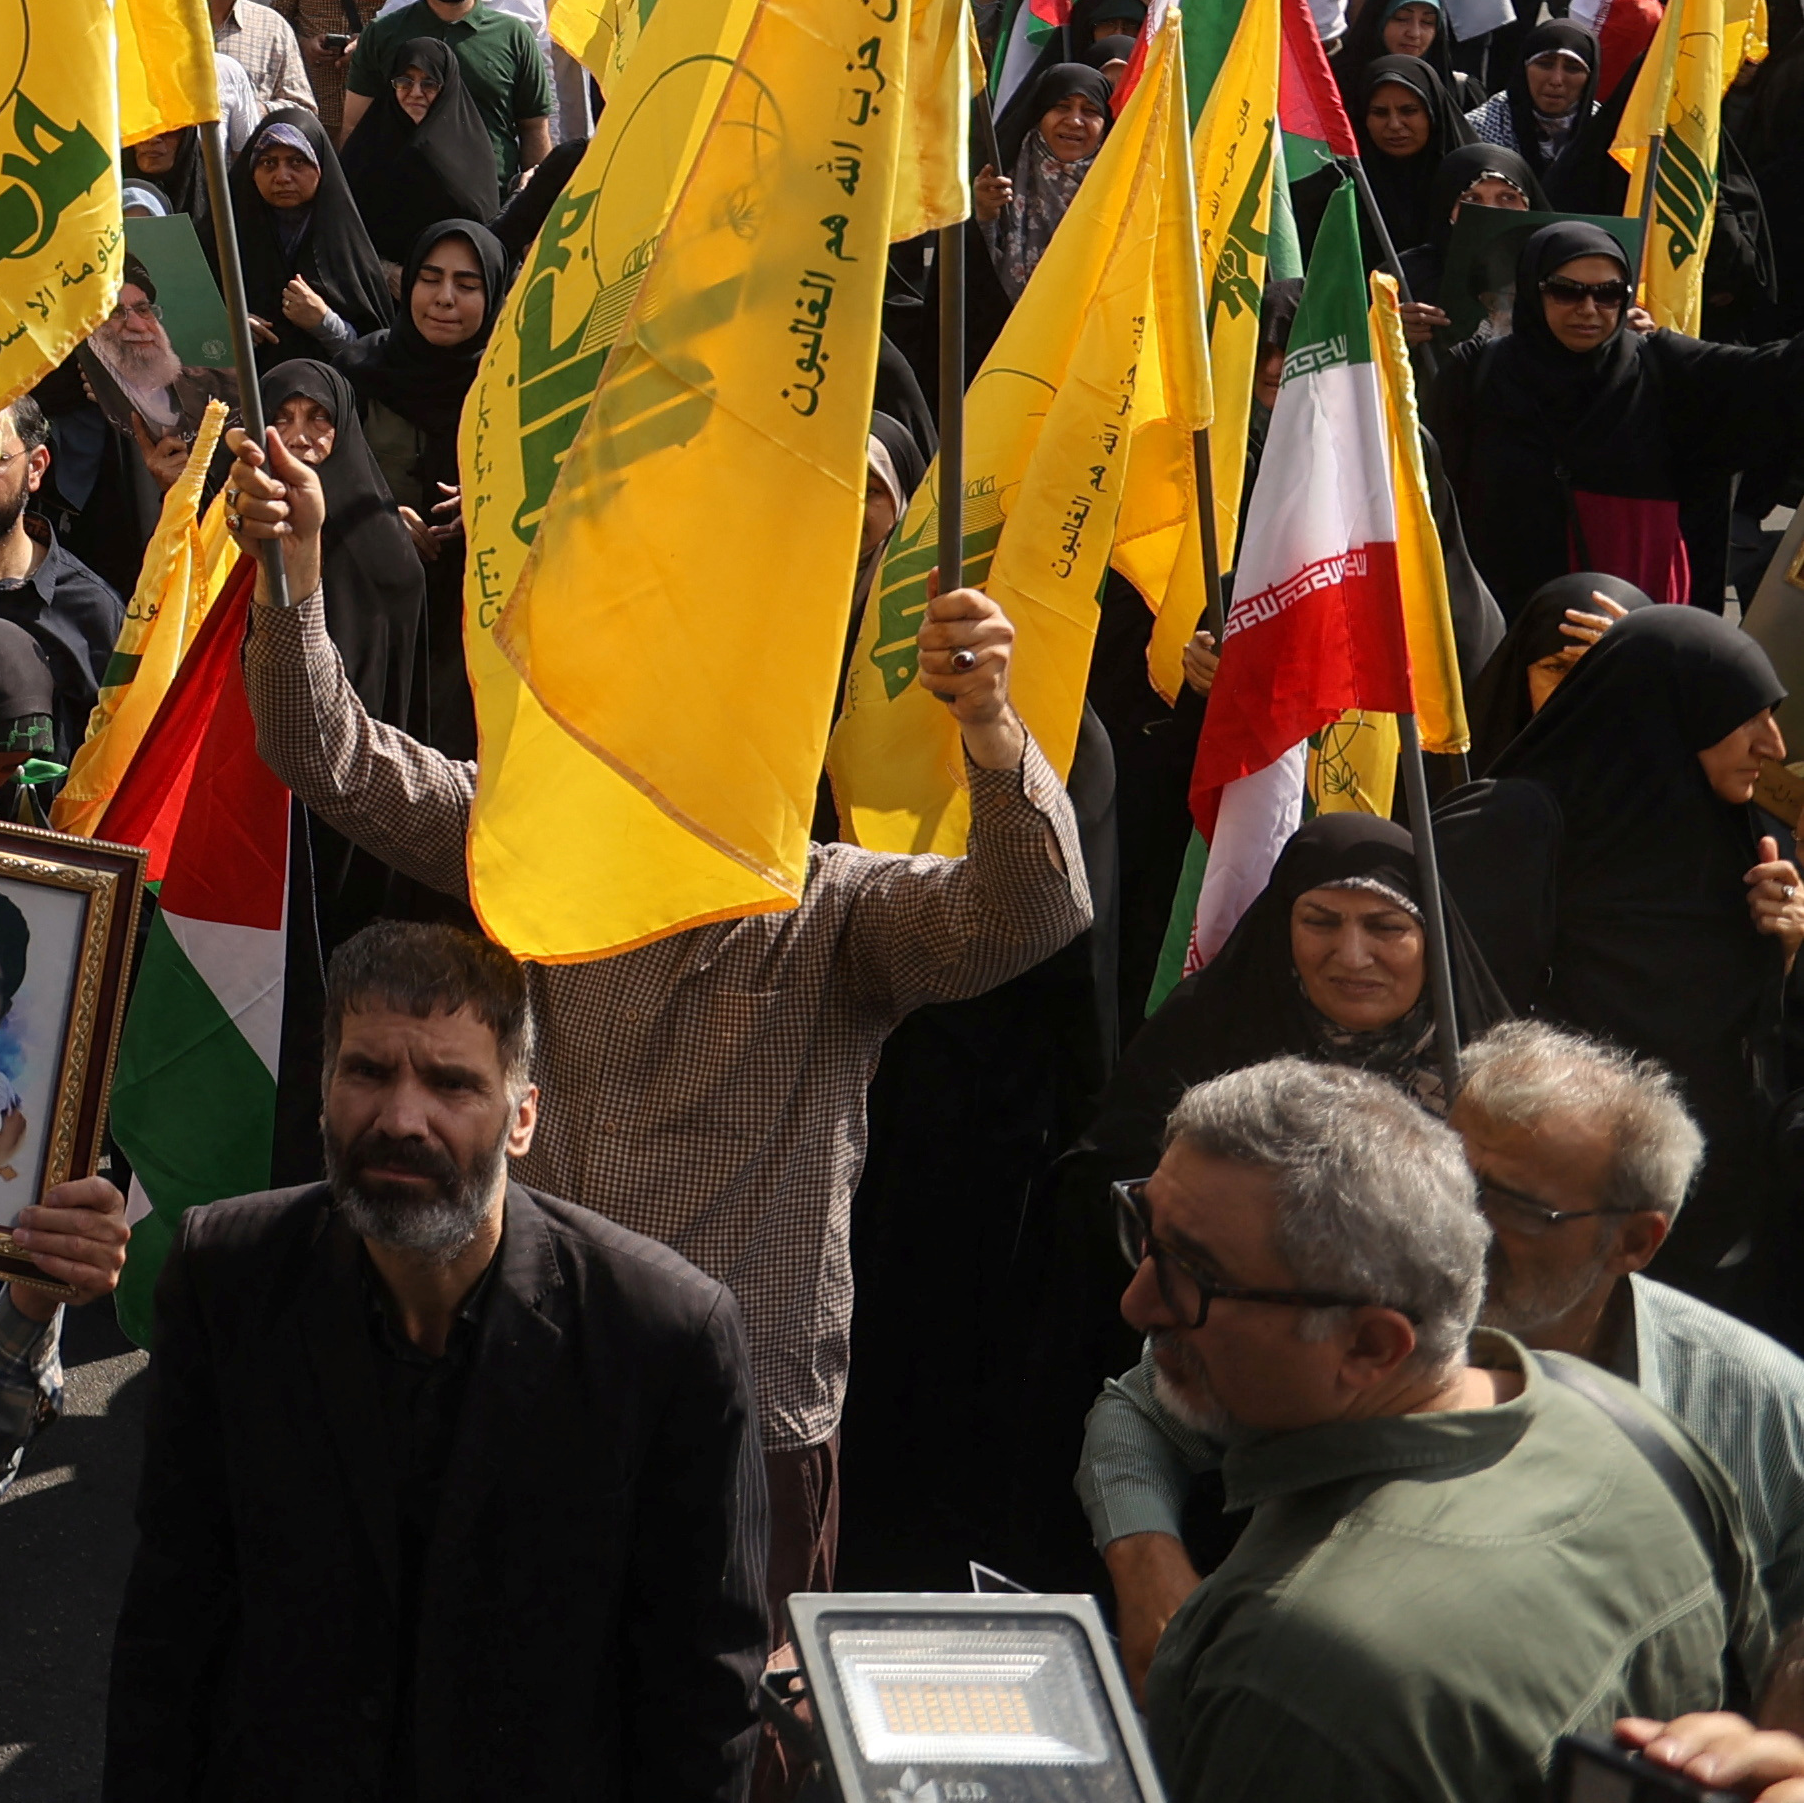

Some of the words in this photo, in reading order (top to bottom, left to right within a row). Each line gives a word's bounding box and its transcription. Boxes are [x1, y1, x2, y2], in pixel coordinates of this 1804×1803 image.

[815, 139, 863, 197] الله
[819, 213, 858, 262] هم
[780, 268, 836, 417] الغالبون
